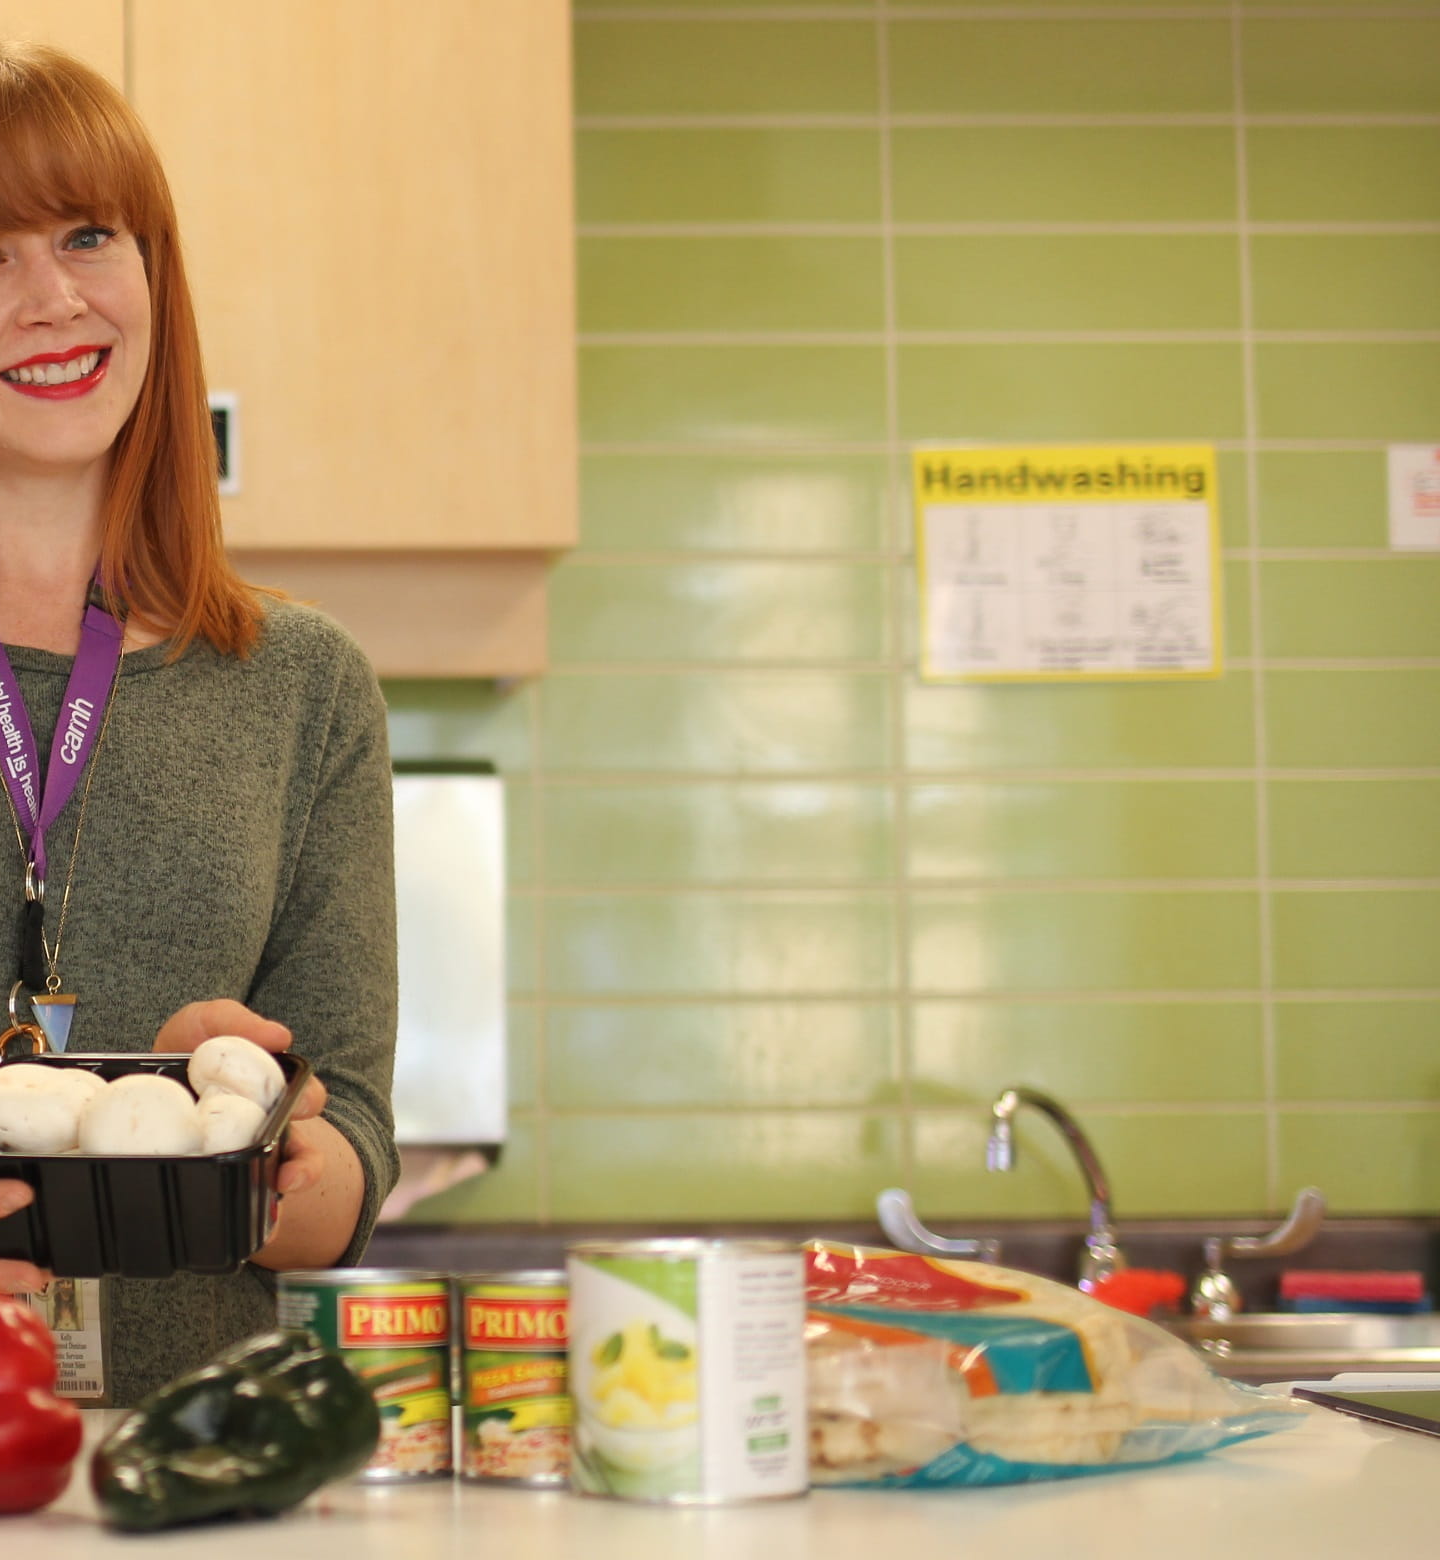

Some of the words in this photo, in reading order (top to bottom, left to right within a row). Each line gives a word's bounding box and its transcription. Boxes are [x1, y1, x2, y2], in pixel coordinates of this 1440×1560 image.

[922, 458, 1206, 499] Handwashing
[60, 697, 94, 765] camh
[349, 1305, 444, 1336] PRIMO
[470, 1307, 569, 1340] PRIMO
